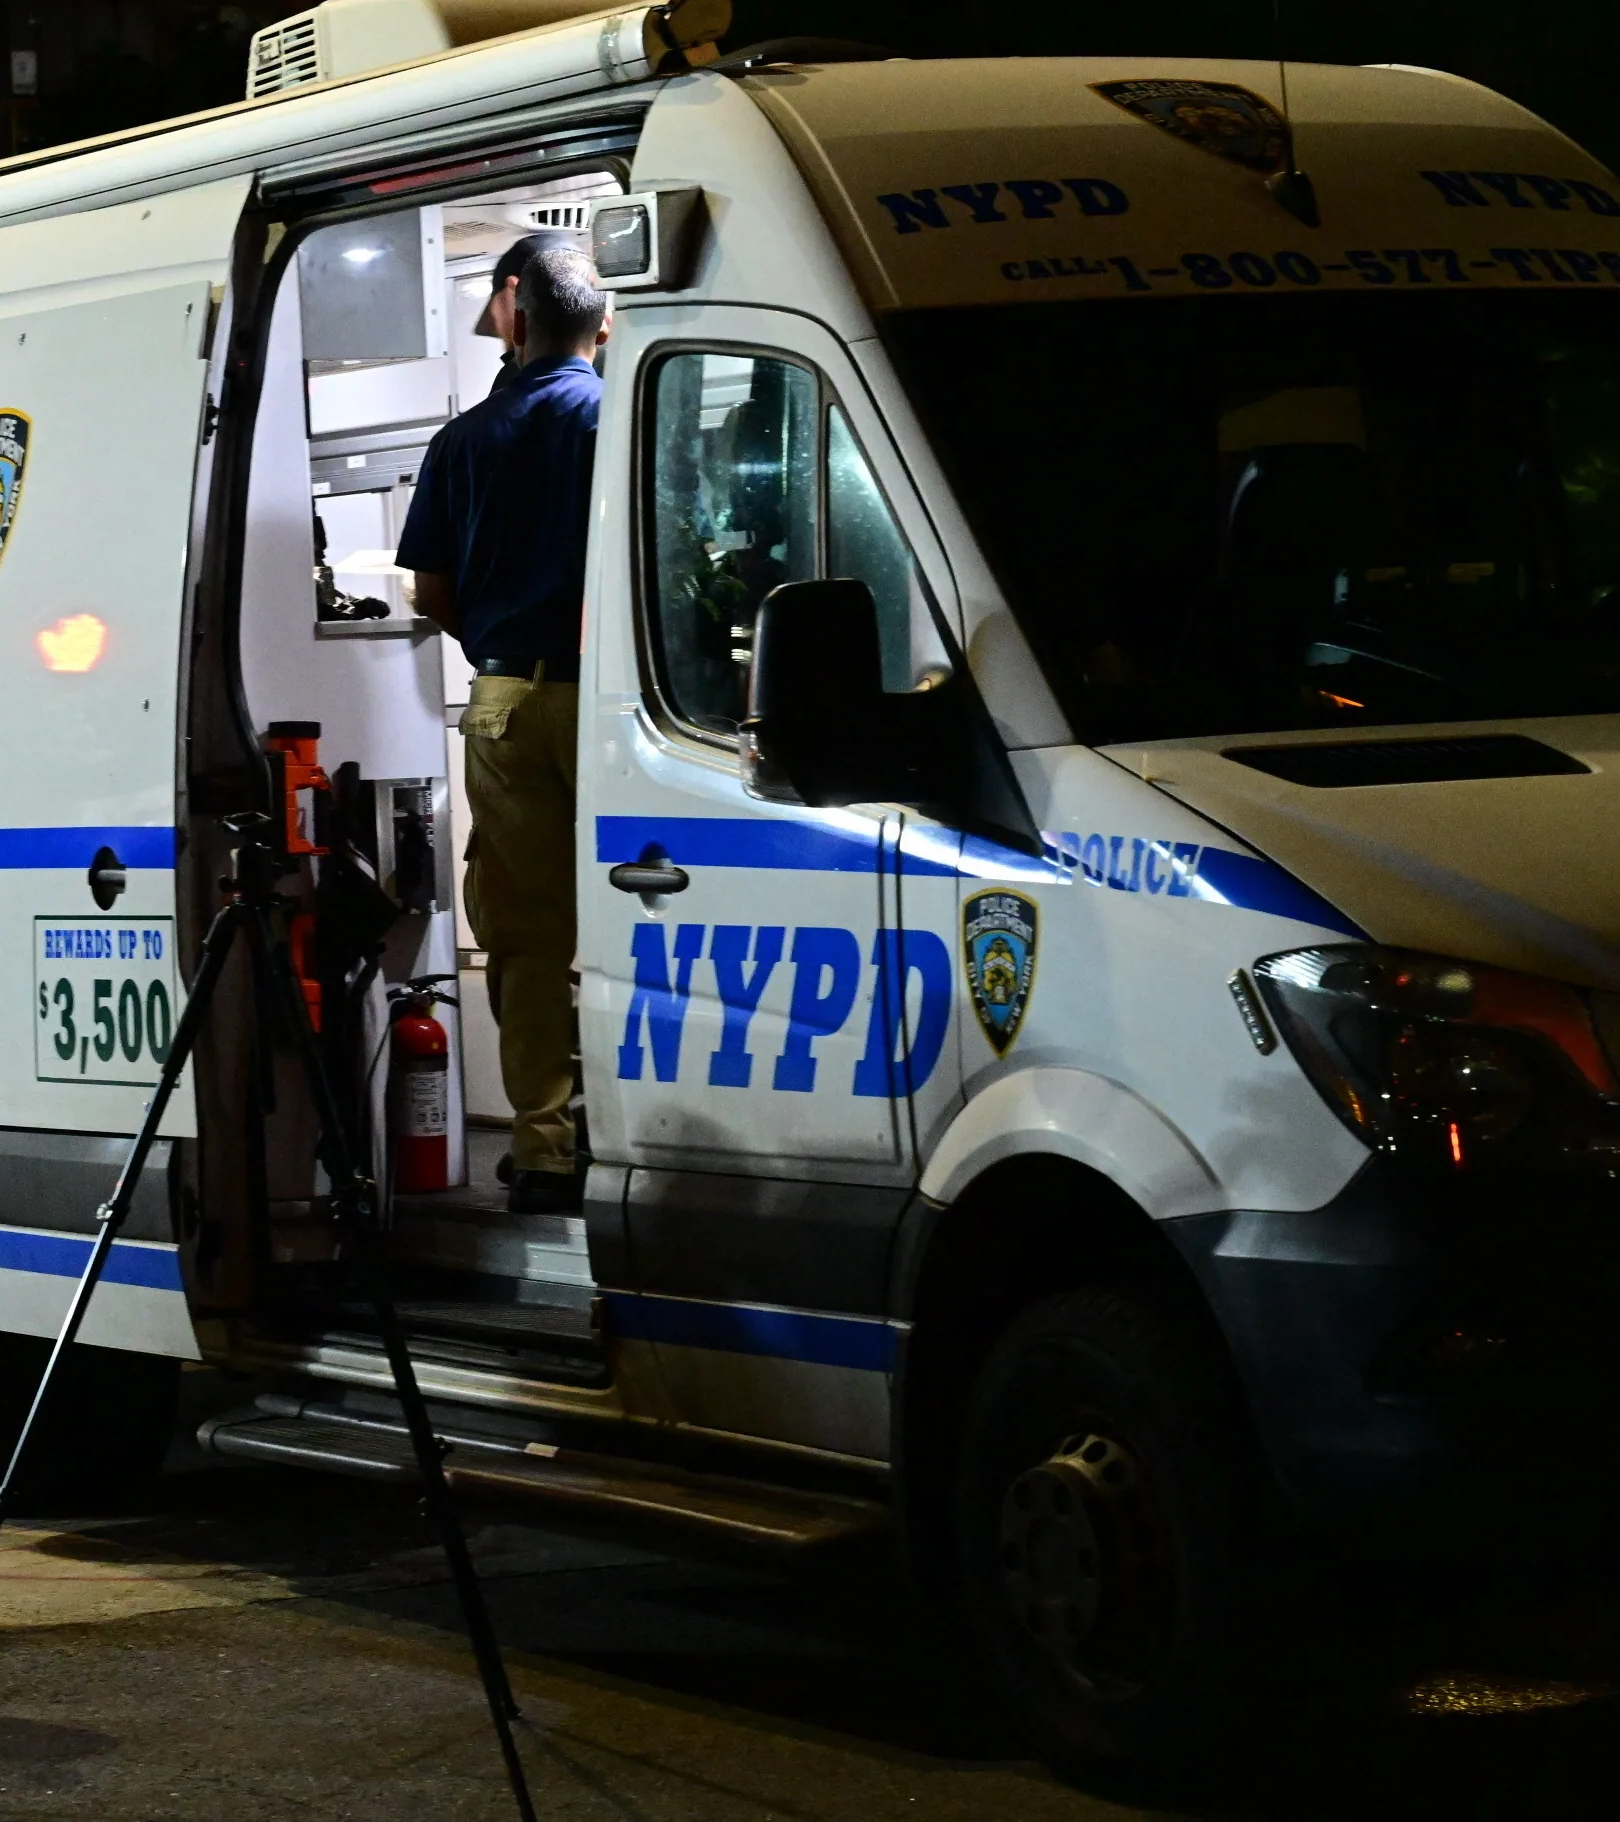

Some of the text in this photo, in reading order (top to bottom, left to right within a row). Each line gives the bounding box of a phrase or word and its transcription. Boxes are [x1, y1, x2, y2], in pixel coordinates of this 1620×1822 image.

[878, 179, 1131, 234] NYPD
[1420, 171, 1620, 217] NYPD
[1057, 831, 1200, 897] POLICE
[980, 896, 1020, 917] POLICE
[45, 929, 163, 960] REWARDS UP TO
[39, 977, 171, 1074] $3,500
[618, 923, 952, 1098] NYPD
